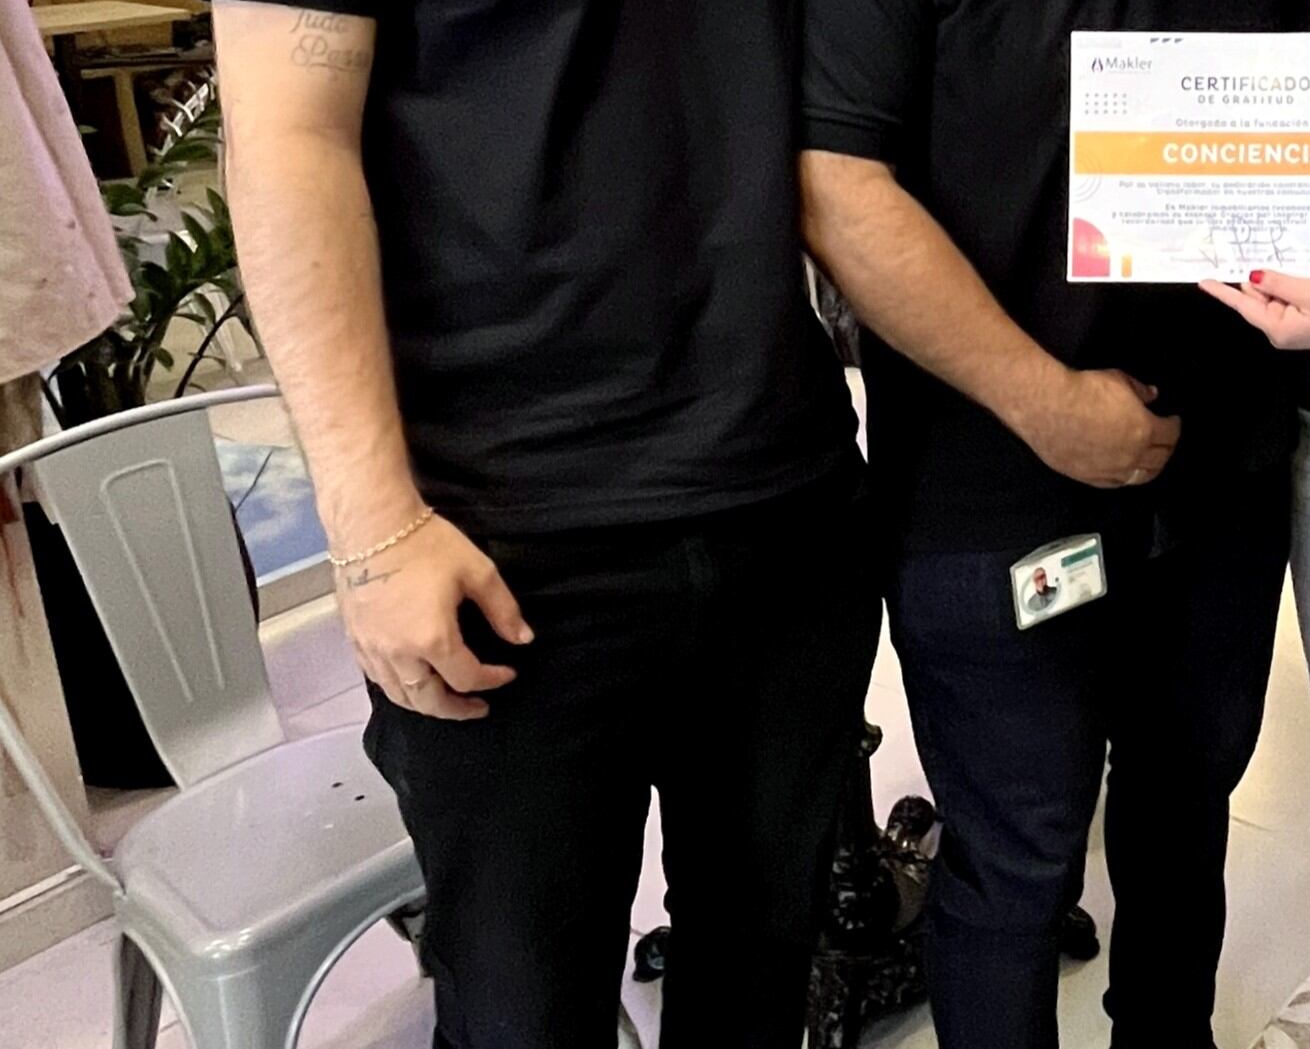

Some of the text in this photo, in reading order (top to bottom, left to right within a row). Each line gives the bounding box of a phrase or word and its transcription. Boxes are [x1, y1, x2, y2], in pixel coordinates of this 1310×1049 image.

[1105, 56, 1152, 70] Makler
[1197, 94, 1295, 105] DE GRATITUD
[1175, 117, 1310, 129] Otorgado a la fundación
